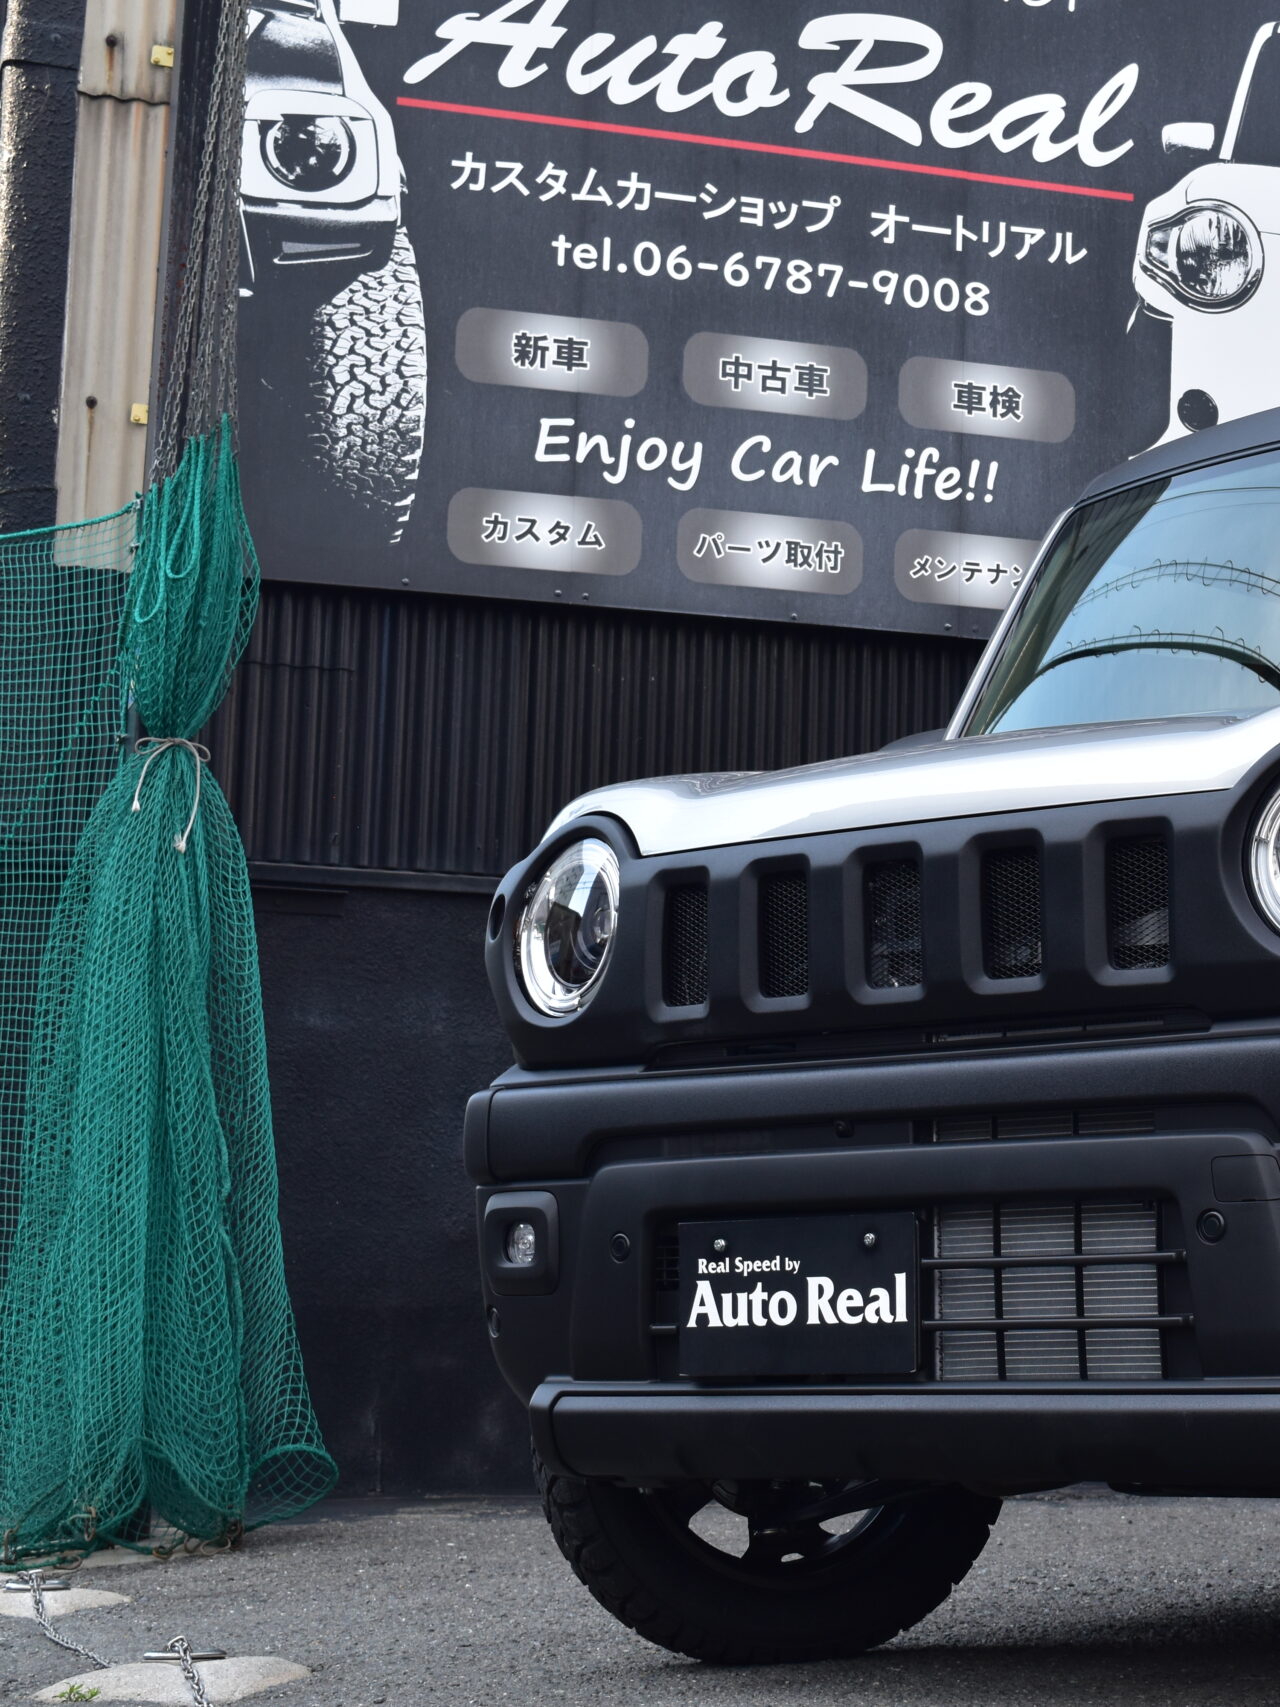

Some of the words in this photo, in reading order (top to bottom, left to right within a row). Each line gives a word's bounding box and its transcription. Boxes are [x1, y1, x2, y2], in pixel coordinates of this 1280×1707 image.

[450, 151, 842, 233] カスタムカーショップ
[870, 204, 1088, 265] オートリアル
[551, 233, 991, 317] tel.06-6787-9008
[512, 331, 589, 372] 新車
[719, 355, 829, 398] 中古車
[952, 381, 1023, 420] 車検
[534, 417, 703, 492] Enjoy
[730, 434, 840, 488] Car
[860, 446, 999, 504] Life!!
[482, 514, 604, 549] カスタム
[695, 534, 844, 573] パーツ取付
[698, 1257, 730, 1274] Real
[734, 1255, 781, 1277] Speed
[785, 1257, 801, 1275] by
[686, 1280, 798, 1328] Auto
[806, 1272, 908, 1325] Real
